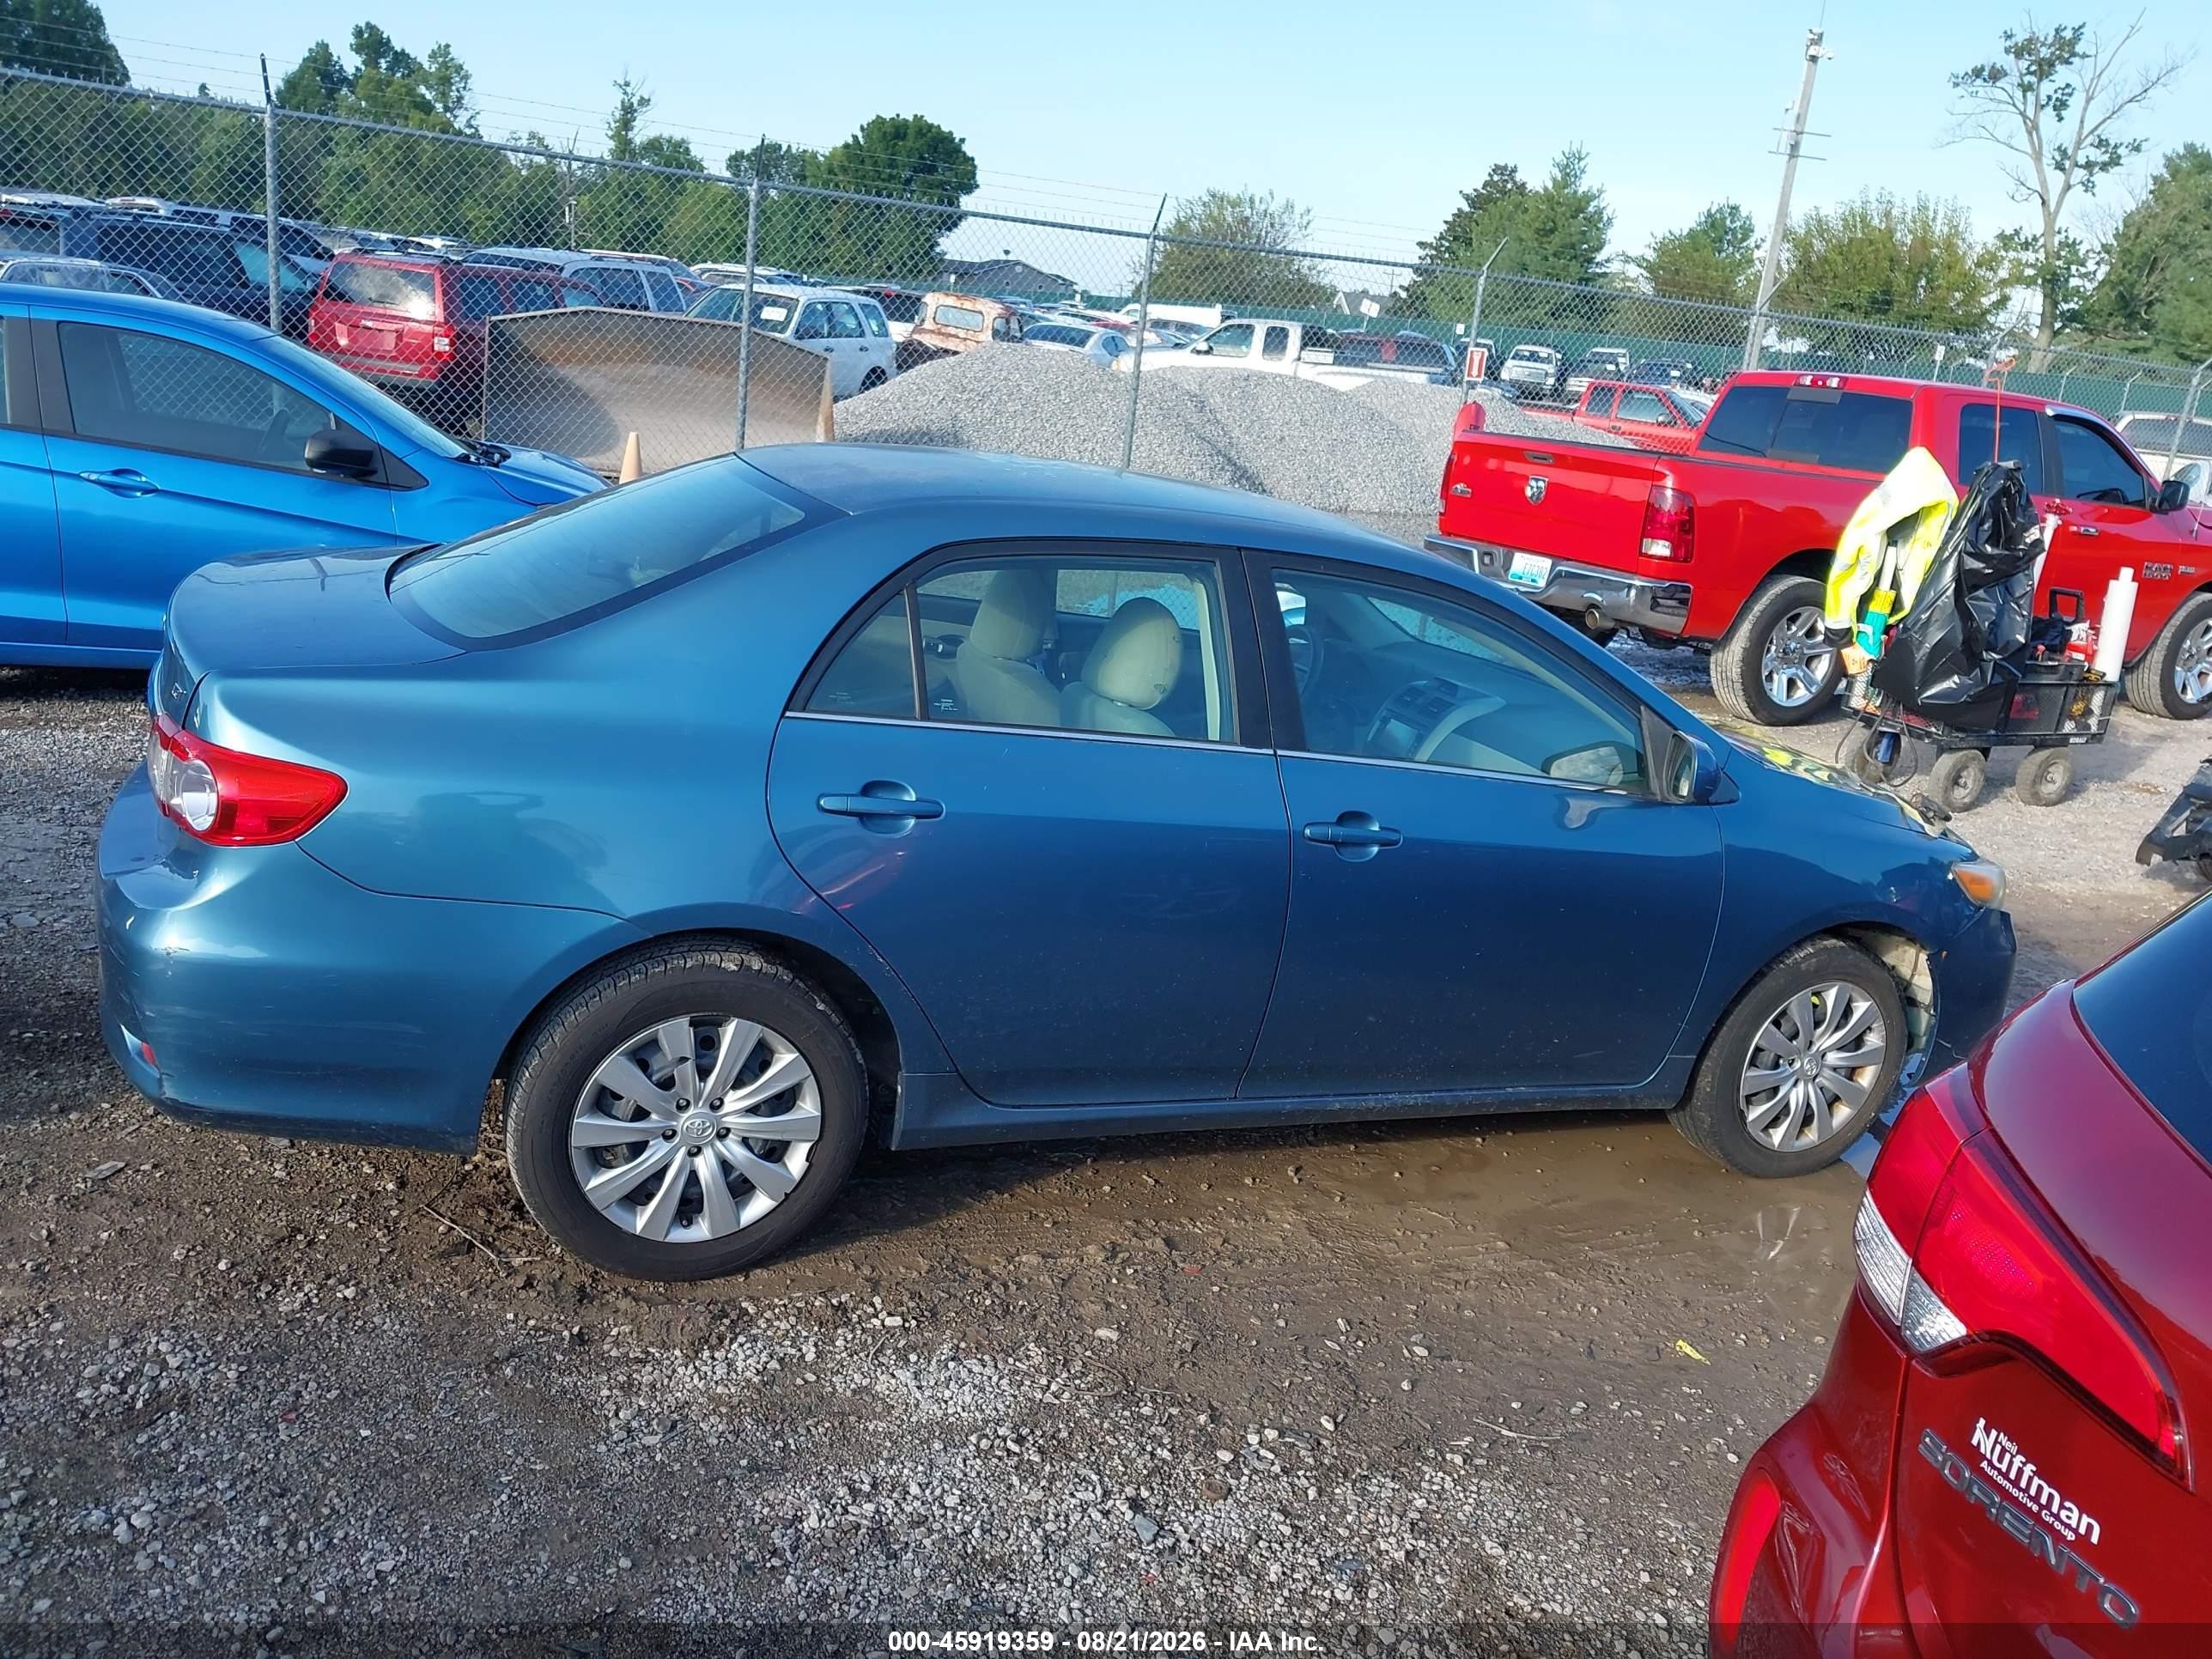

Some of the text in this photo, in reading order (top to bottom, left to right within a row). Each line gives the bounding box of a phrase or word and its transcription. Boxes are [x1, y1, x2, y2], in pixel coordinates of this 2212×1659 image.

[1971, 1417, 2100, 1546] Nuffman
[1998, 1432, 2018, 1455] Neil
[1917, 1428, 2141, 1630] SORENTO
[1979, 1460, 2075, 1541] Automotive Group
